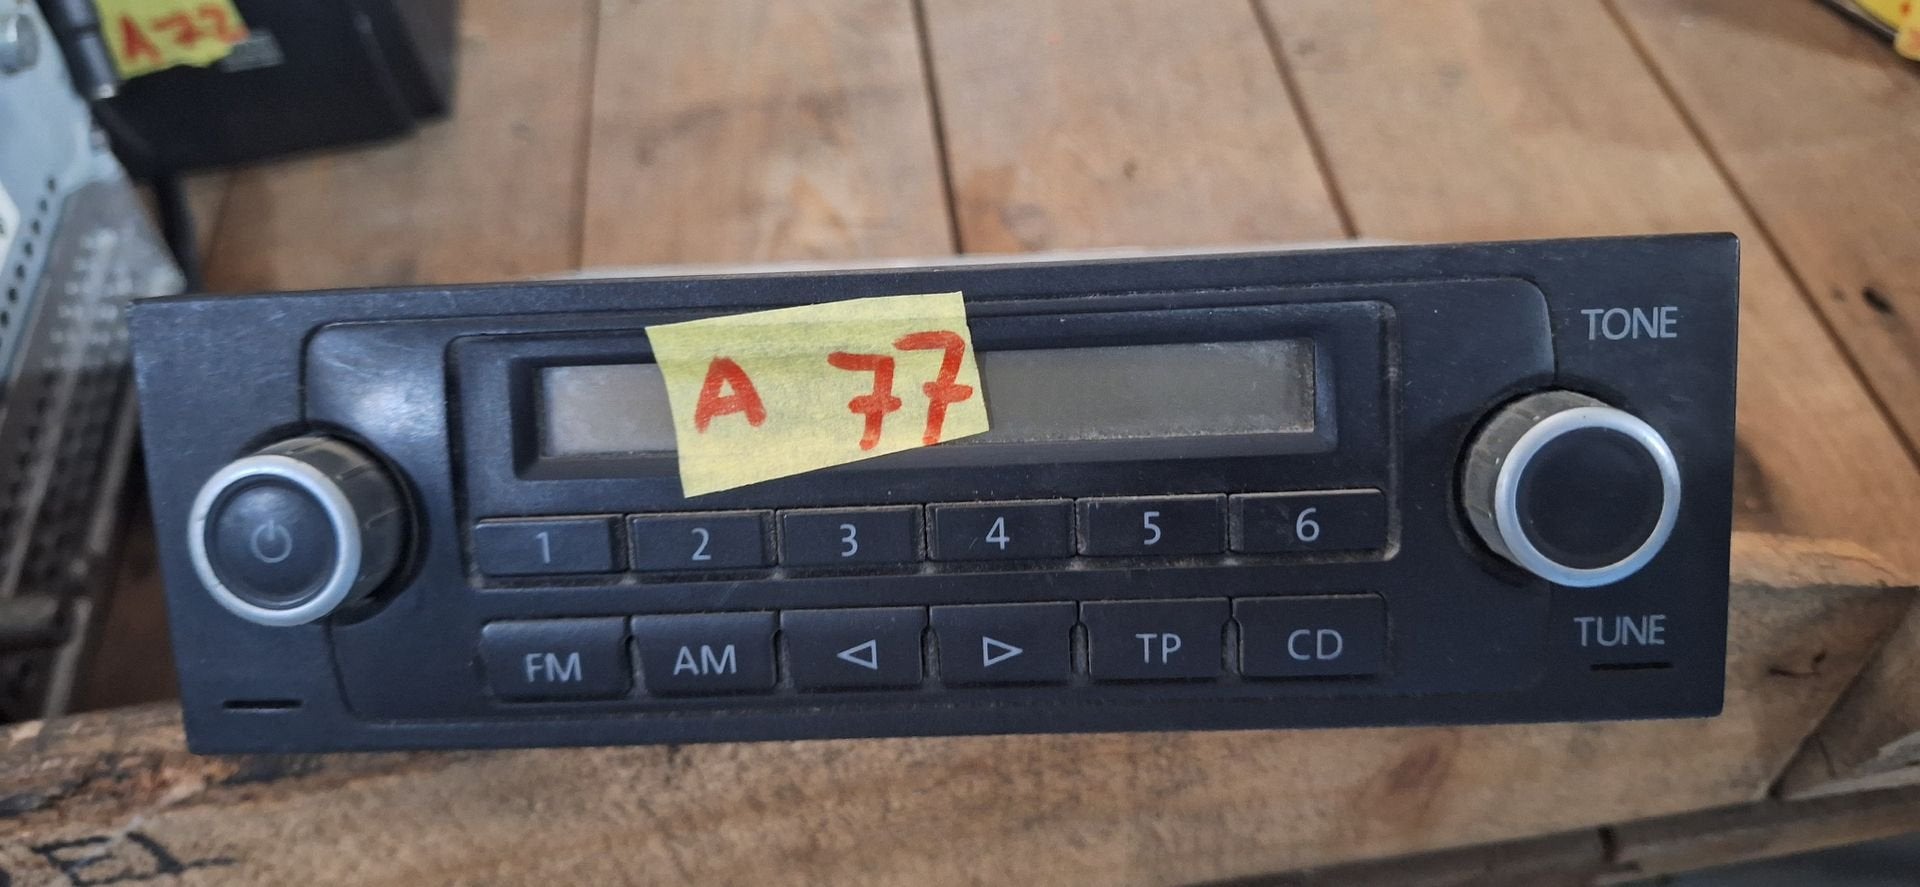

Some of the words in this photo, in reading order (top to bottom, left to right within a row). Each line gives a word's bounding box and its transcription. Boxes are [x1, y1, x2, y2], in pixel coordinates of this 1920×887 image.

[1580, 306, 1678, 341] TONE
[694, 355, 767, 434] A
[826, 330, 974, 451] 77
[839, 523, 859, 557] 3
[985, 516, 1010, 550] 4
[1143, 511, 1162, 545] 5
[1295, 507, 1320, 542] 6
[535, 531, 551, 564] 1
[691, 528, 712, 561] 2
[1287, 629, 1343, 661] CD
[1573, 614, 1666, 647] TUNE
[673, 644, 737, 676] AM
[1135, 633, 1182, 664] TP
[525, 652, 583, 683] FM
